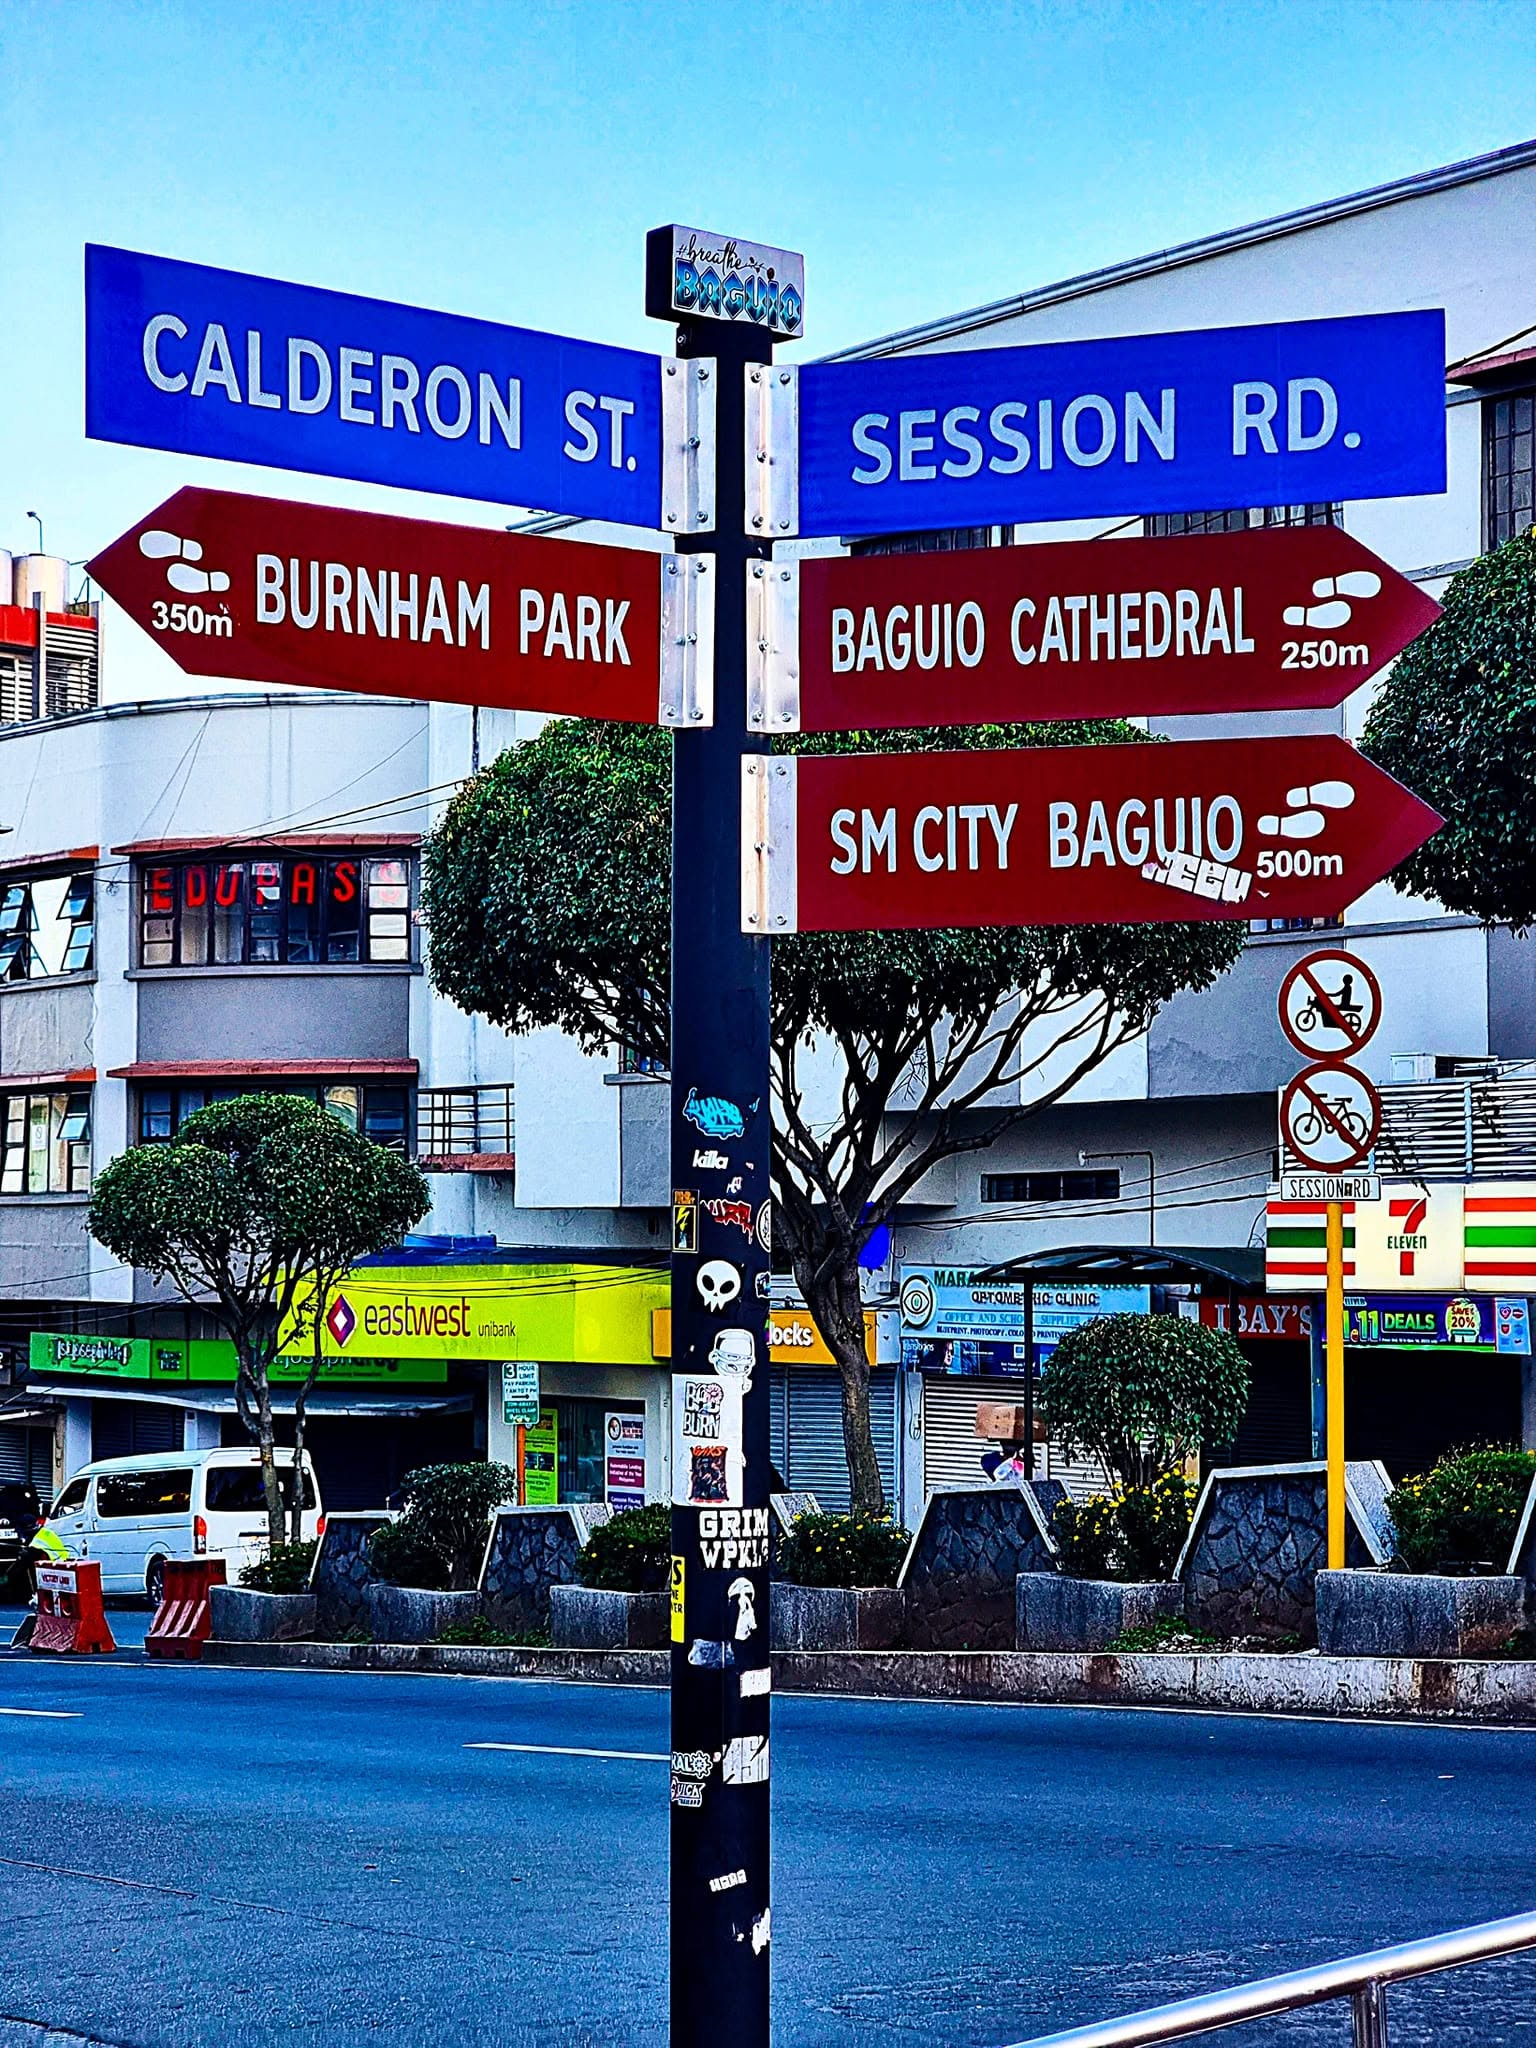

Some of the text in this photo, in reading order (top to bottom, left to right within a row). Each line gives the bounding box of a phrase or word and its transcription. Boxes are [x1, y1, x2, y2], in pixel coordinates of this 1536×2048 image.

[676, 234, 746, 275] #breathe
[142, 314, 637, 471] CALDERON ST.
[851, 377, 1361, 484] SESSION RD.
[151, 601, 233, 637] 350m
[256, 554, 632, 666] BURNHAM PARK
[832, 587, 1255, 673] BAGUIO CATHEDRAL
[1281, 640, 1369, 669] 250m
[830, 795, 1243, 875] SM CITY BAGUIO
[1256, 850, 1343, 878] 500m
[1290, 1179, 1371, 1198] SESSION RD
[1389, 1199, 1427, 1276] 7
[971, 1291, 1099, 1306] OPTOMERIC CLINIC
[365, 1297, 516, 1337] eastwest unibank
[979, 1313, 997, 1323] AND
[1384, 1313, 1435, 1330] DEALS
[1451, 1316, 1475, 1328] 20%
[506, 1364, 516, 1378] 3
[699, 1508, 769, 1538] GRIM
